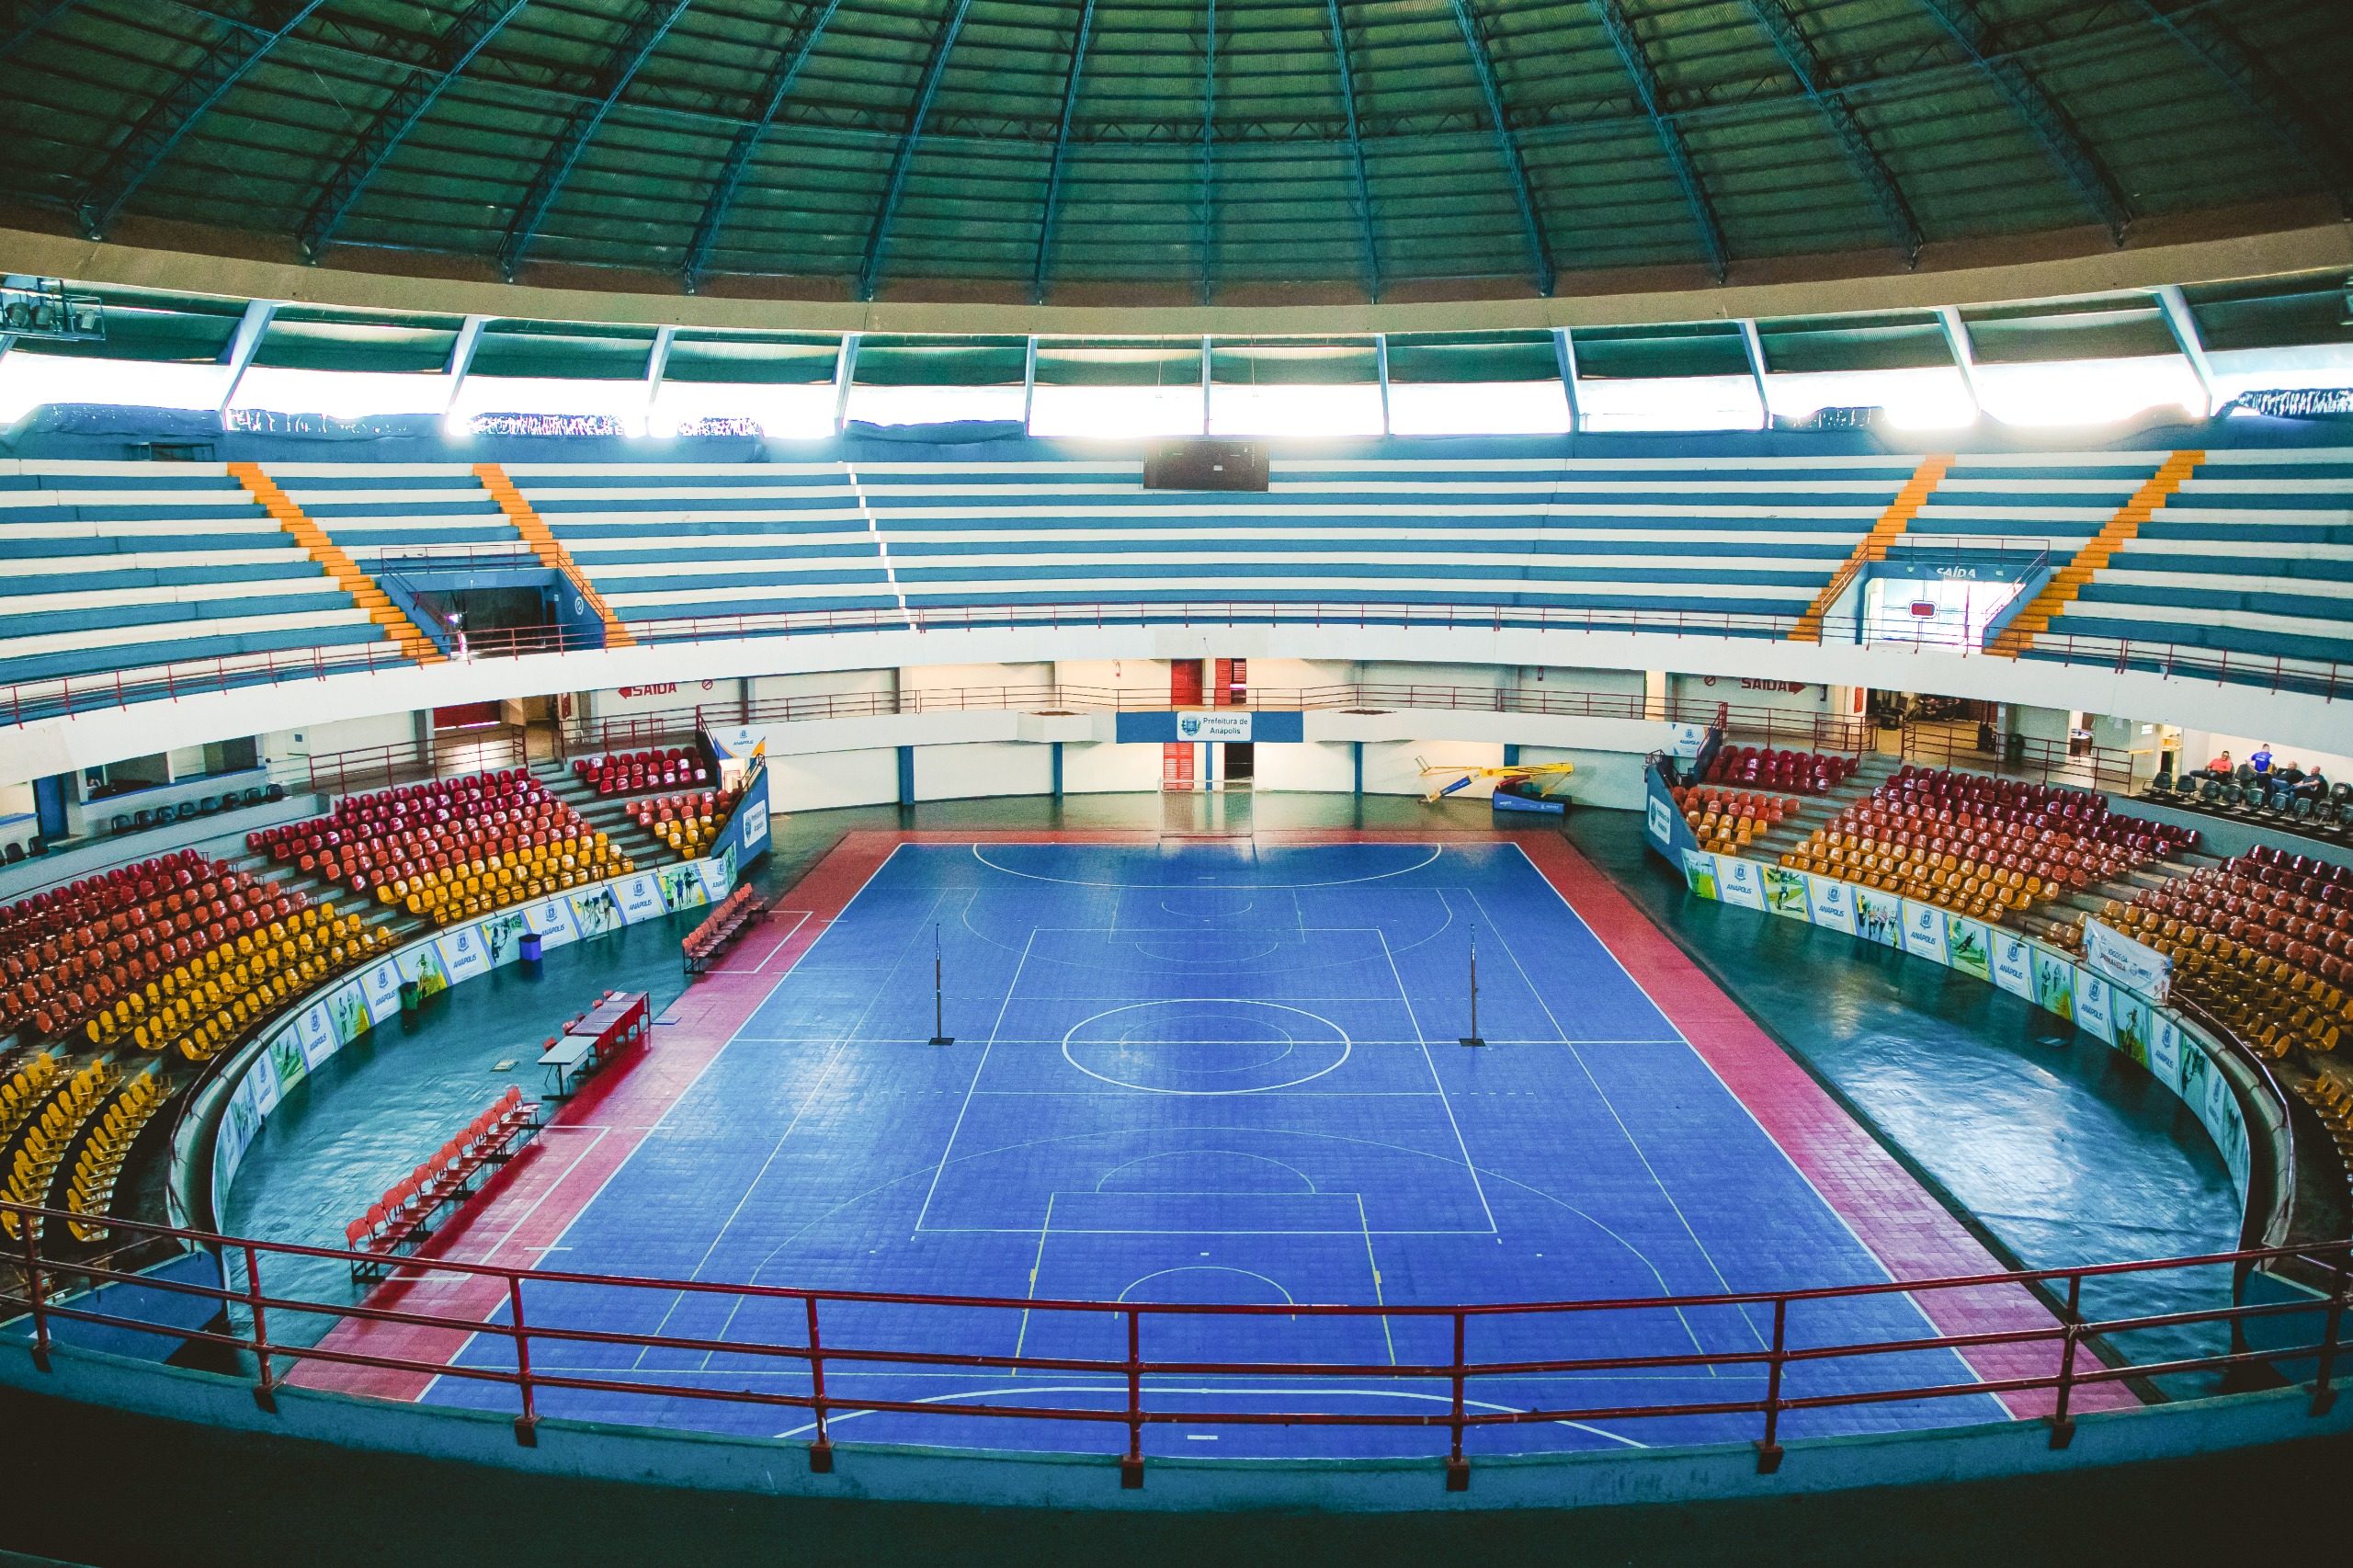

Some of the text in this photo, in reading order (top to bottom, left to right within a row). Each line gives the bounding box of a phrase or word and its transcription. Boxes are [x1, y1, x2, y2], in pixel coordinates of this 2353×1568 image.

[1203, 717, 1248, 725] Prefeitura de
[1210, 727, 1241, 735] Anápolis
